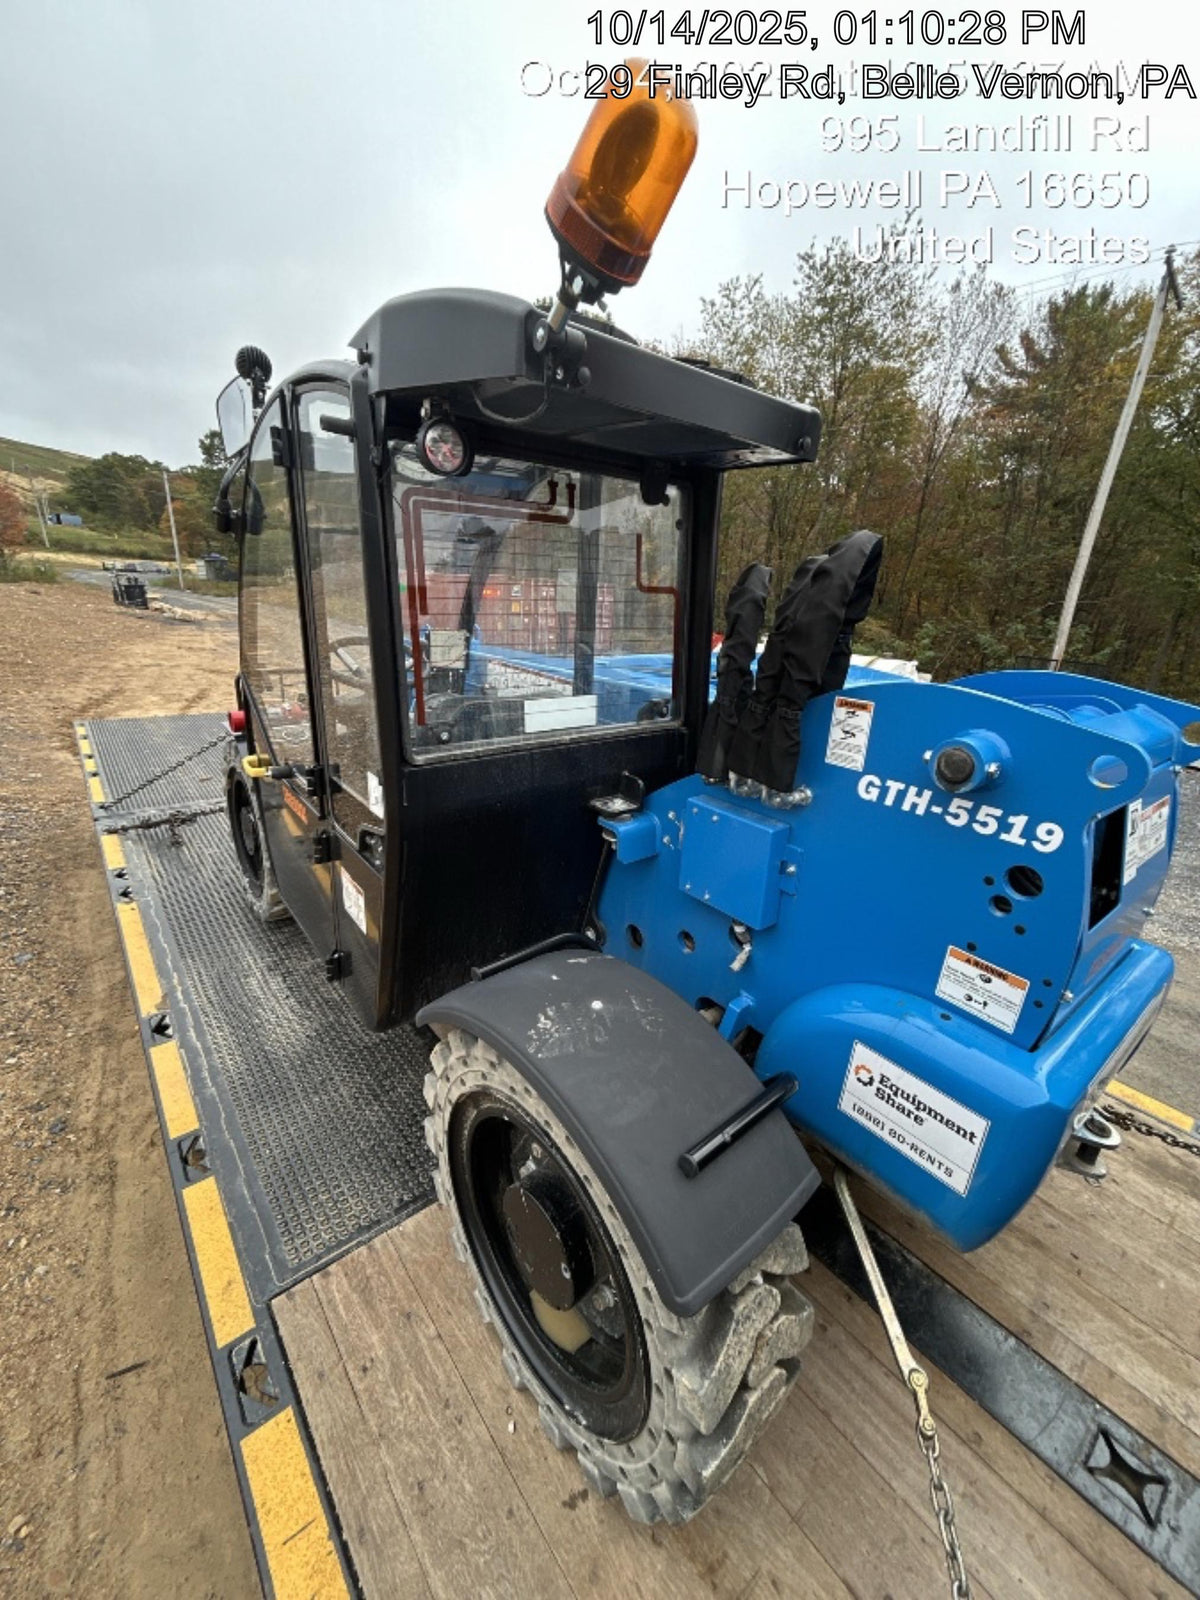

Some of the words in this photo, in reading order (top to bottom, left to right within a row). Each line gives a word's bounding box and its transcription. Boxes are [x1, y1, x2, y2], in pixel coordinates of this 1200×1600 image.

[857, 774, 1065, 854] GTH-5519
[874, 1087, 926, 1127] Share
[878, 1073, 978, 1146] Equipment
